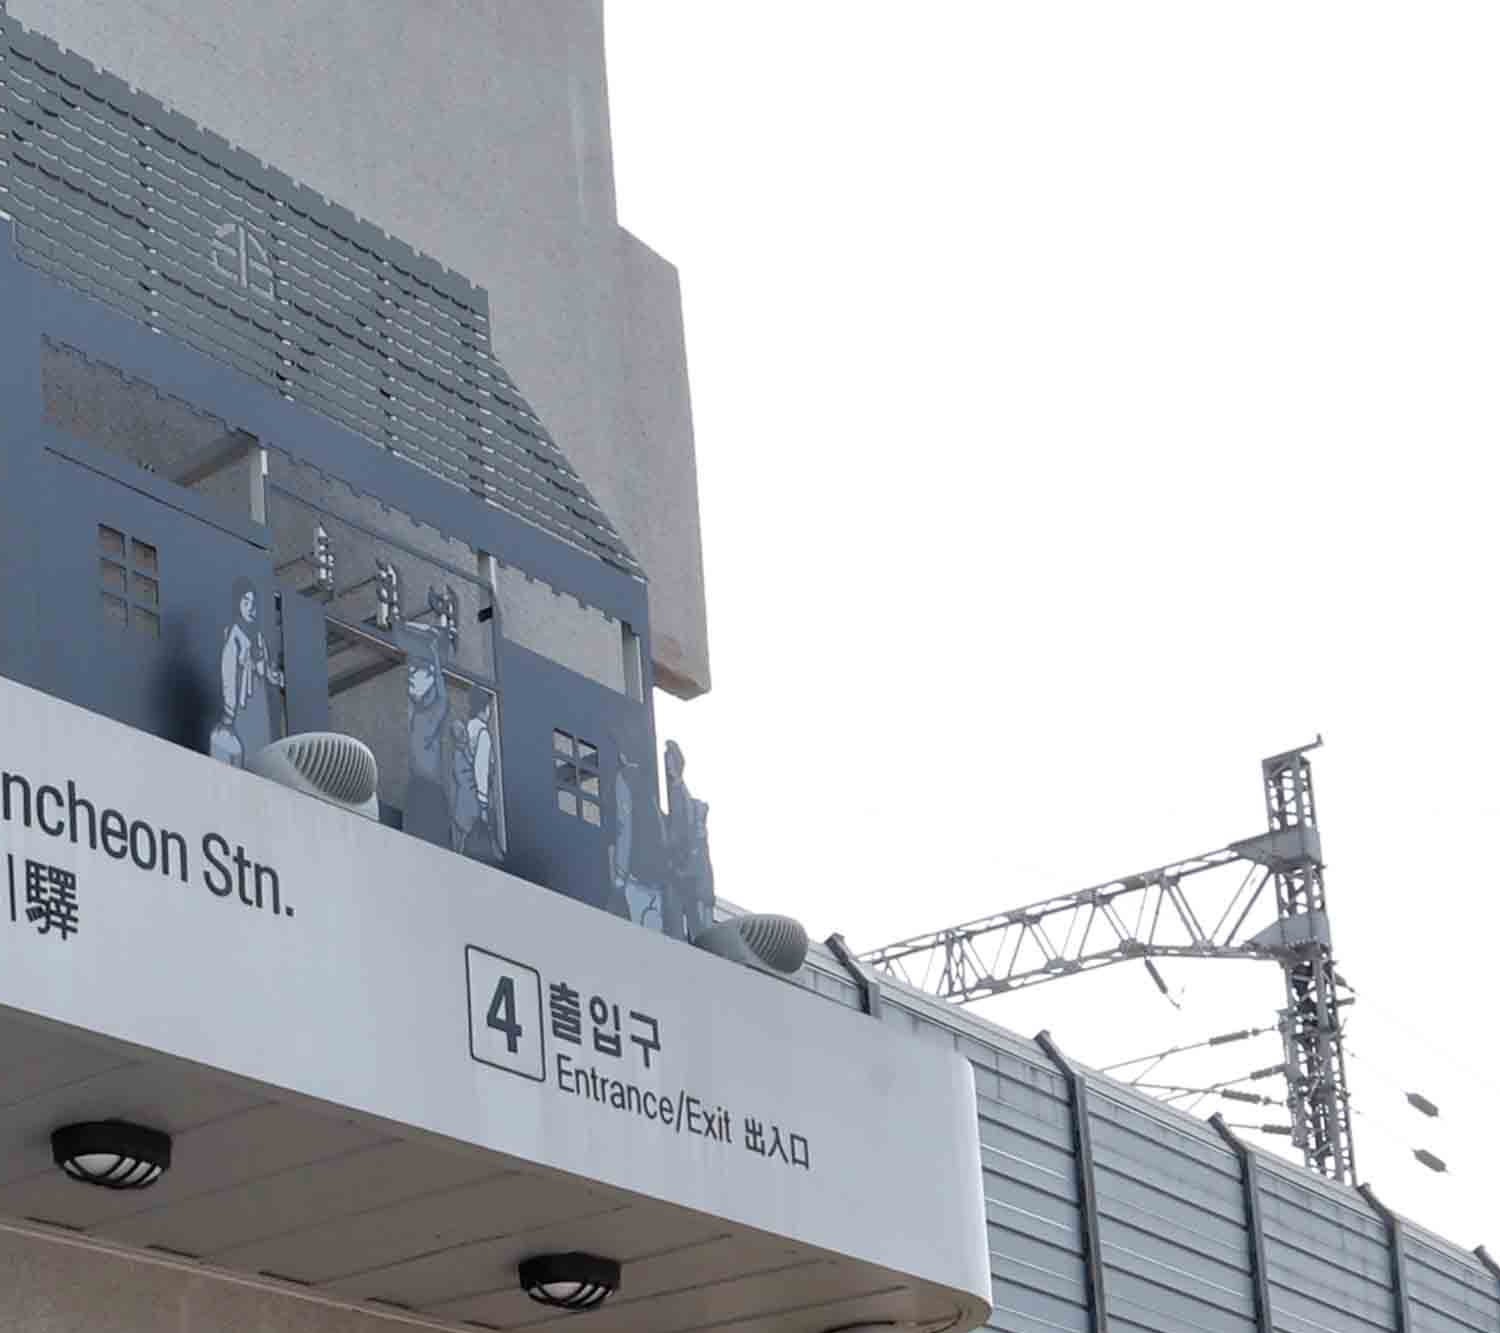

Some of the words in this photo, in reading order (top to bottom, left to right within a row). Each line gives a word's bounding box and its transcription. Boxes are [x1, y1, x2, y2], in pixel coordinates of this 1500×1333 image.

[202, 825, 293, 917] Stn.
[483, 973, 524, 1055] 4
[547, 981, 660, 1073] 출입구
[555, 1053, 731, 1149] Entrance/Exit
[743, 1114, 811, 1171] 出入口
